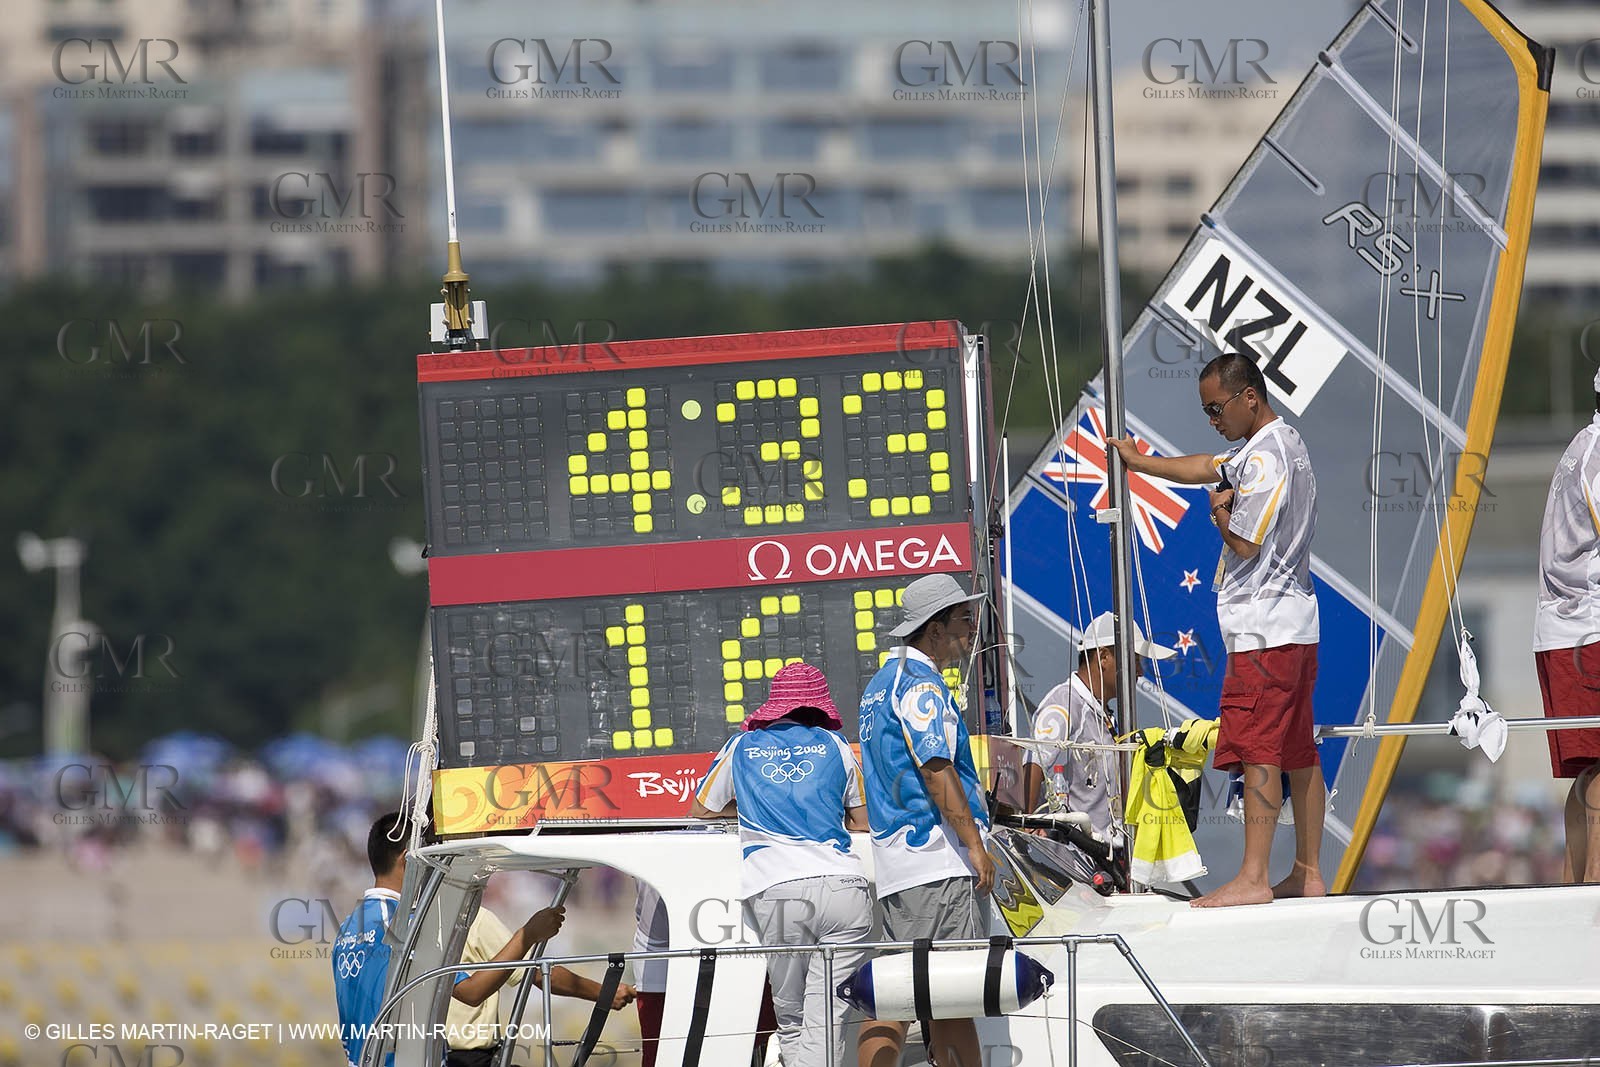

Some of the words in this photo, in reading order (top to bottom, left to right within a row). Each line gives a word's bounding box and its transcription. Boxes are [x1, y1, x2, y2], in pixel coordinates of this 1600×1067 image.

[1184, 253, 1308, 397] NZL
[806, 533, 962, 576] OMEGA
[744, 746, 792, 761] Beijing
[793, 743, 827, 756] 2008
